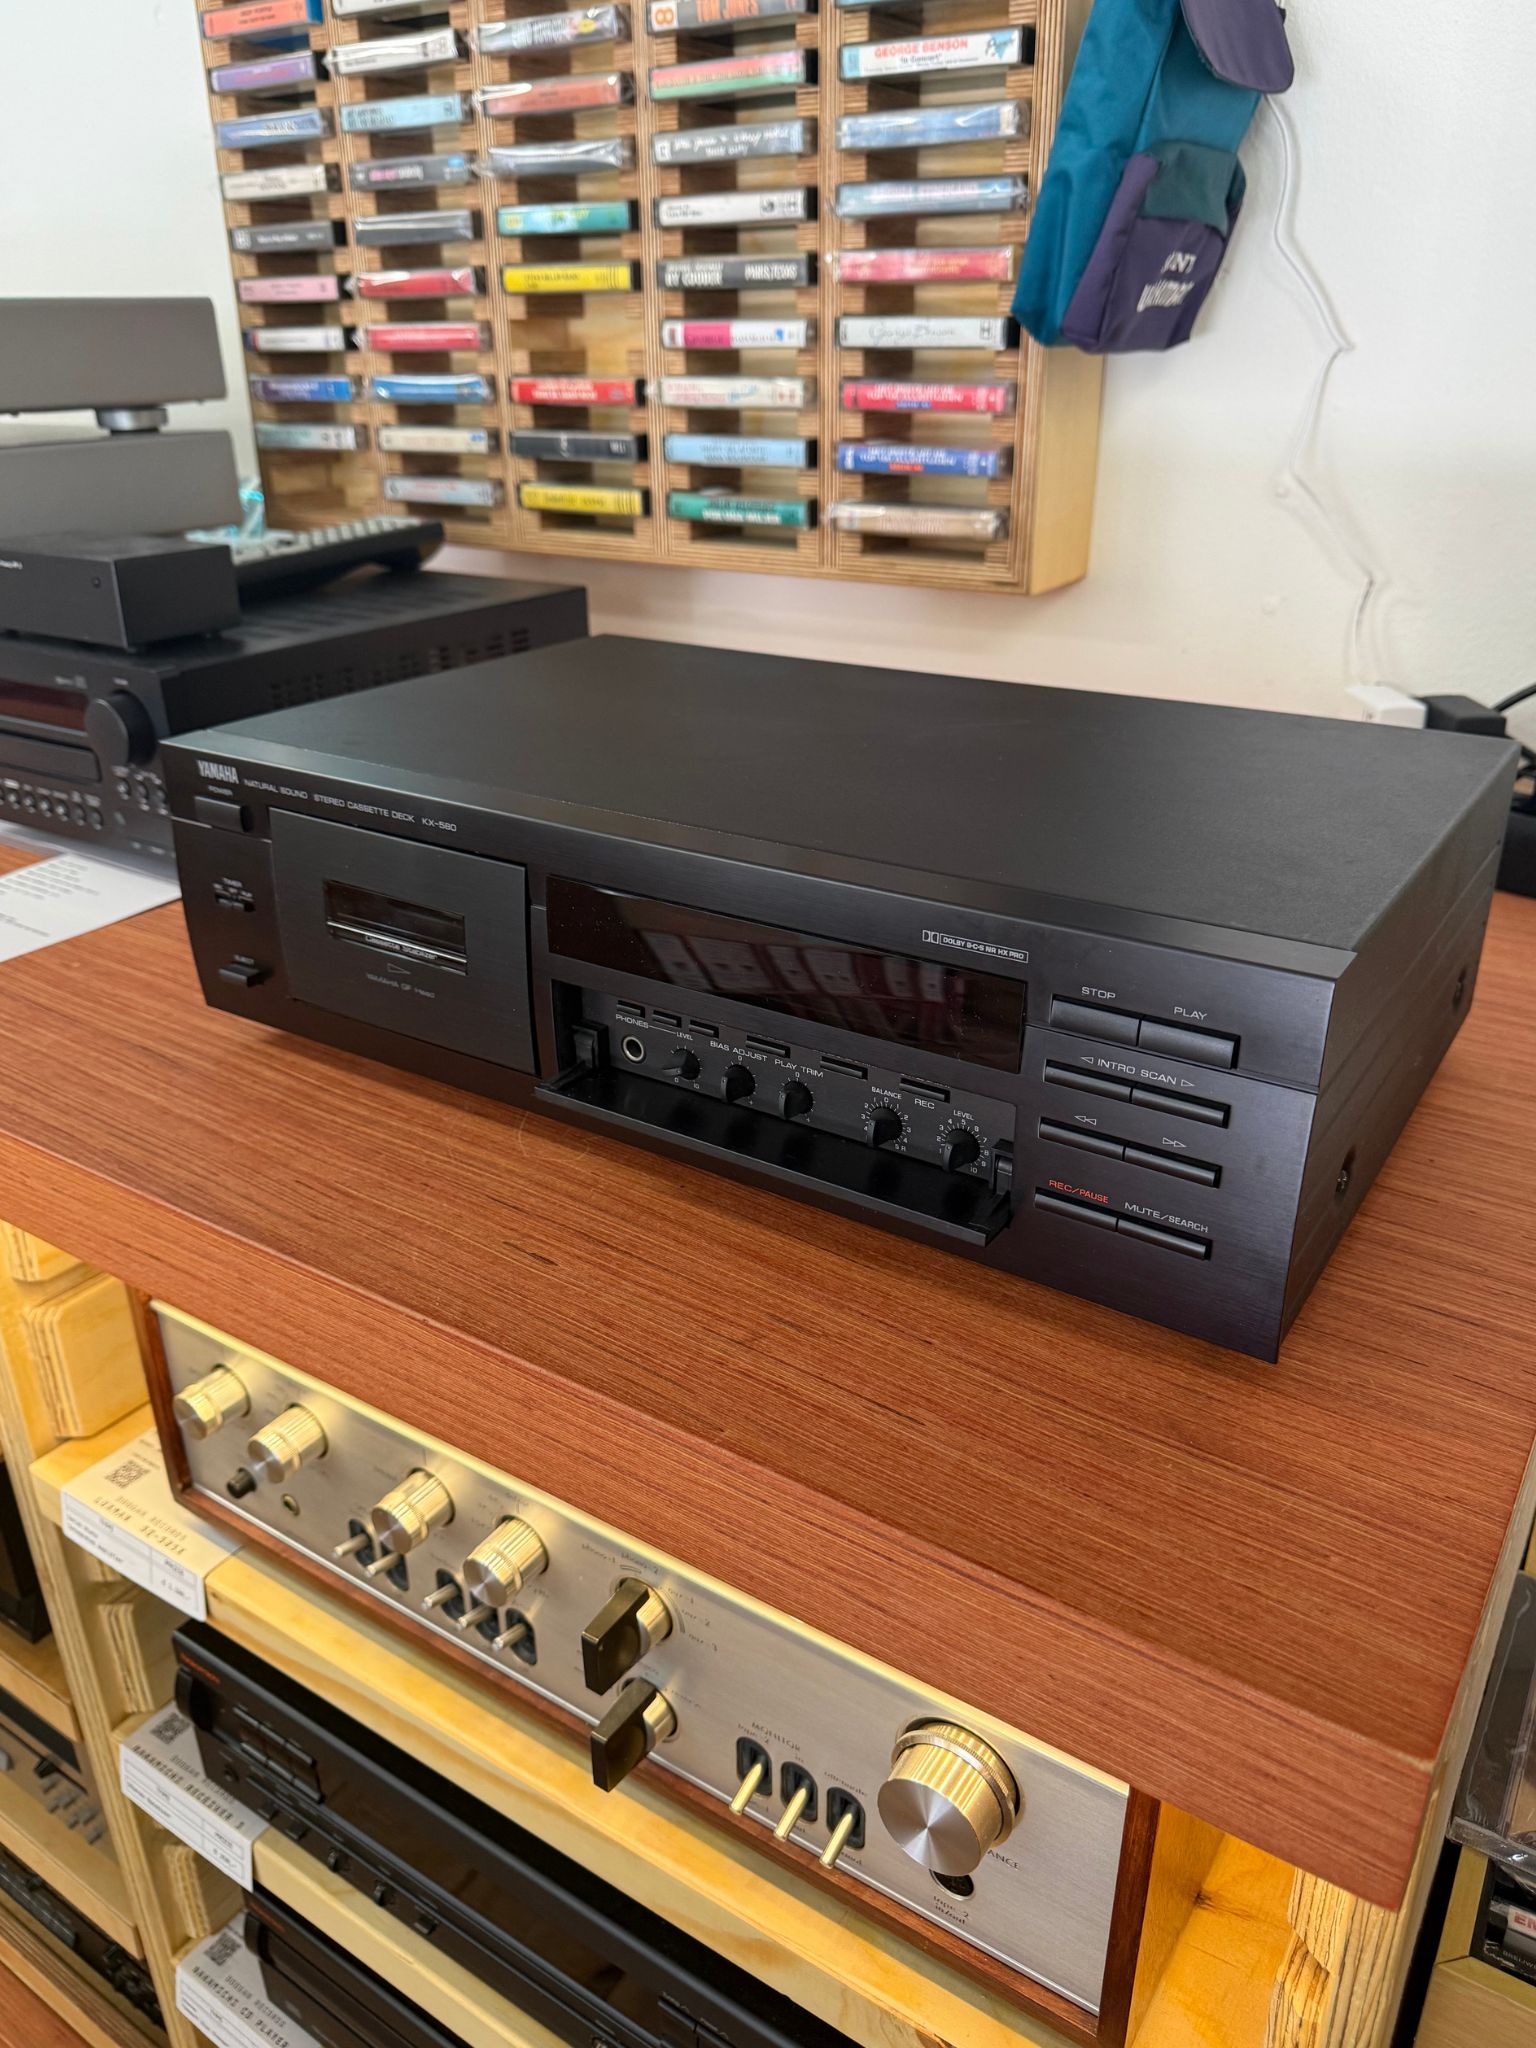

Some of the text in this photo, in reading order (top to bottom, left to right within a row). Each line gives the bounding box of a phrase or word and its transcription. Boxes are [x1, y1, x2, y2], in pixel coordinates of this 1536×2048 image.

[874, 38, 969, 58] GEORGE BENSON
[197, 760, 239, 784] YAMAHA
[243, 778, 279, 793] NATURAL
[280, 786, 308, 799] SOUND
[313, 793, 345, 808] STEREO
[347, 801, 390, 817] CASSETTE
[391, 810, 416, 823] DECK
[943, 936, 966, 948] DOLBY
[985, 946, 997, 954] NR
[997, 948, 1009, 957] HX
[1009, 951, 1024, 960] PRO
[1081, 986, 1116, 999] STOP
[615, 1013, 649, 1029] PHONES
[1173, 1006, 1208, 1020] PLAY
[676, 1031, 694, 1041] LEVEL
[709, 1040, 768, 1062] BIAS ADJUST
[774, 1059, 824, 1078] PLAY TRIM
[1097, 1058, 1177, 1085] INTRO SCAN
[871, 1086, 902, 1100] BALANCE
[914, 1098, 935, 1110] REC
[953, 1109, 975, 1121] LEVEL
[1048, 1179, 1109, 1203] REC/PAUSE
[1124, 1201, 1209, 1233] MUTE/SEARCH
[987, 1848, 1022, 1872] ANCE
[255, 2018, 289, 2048] PLAYER
